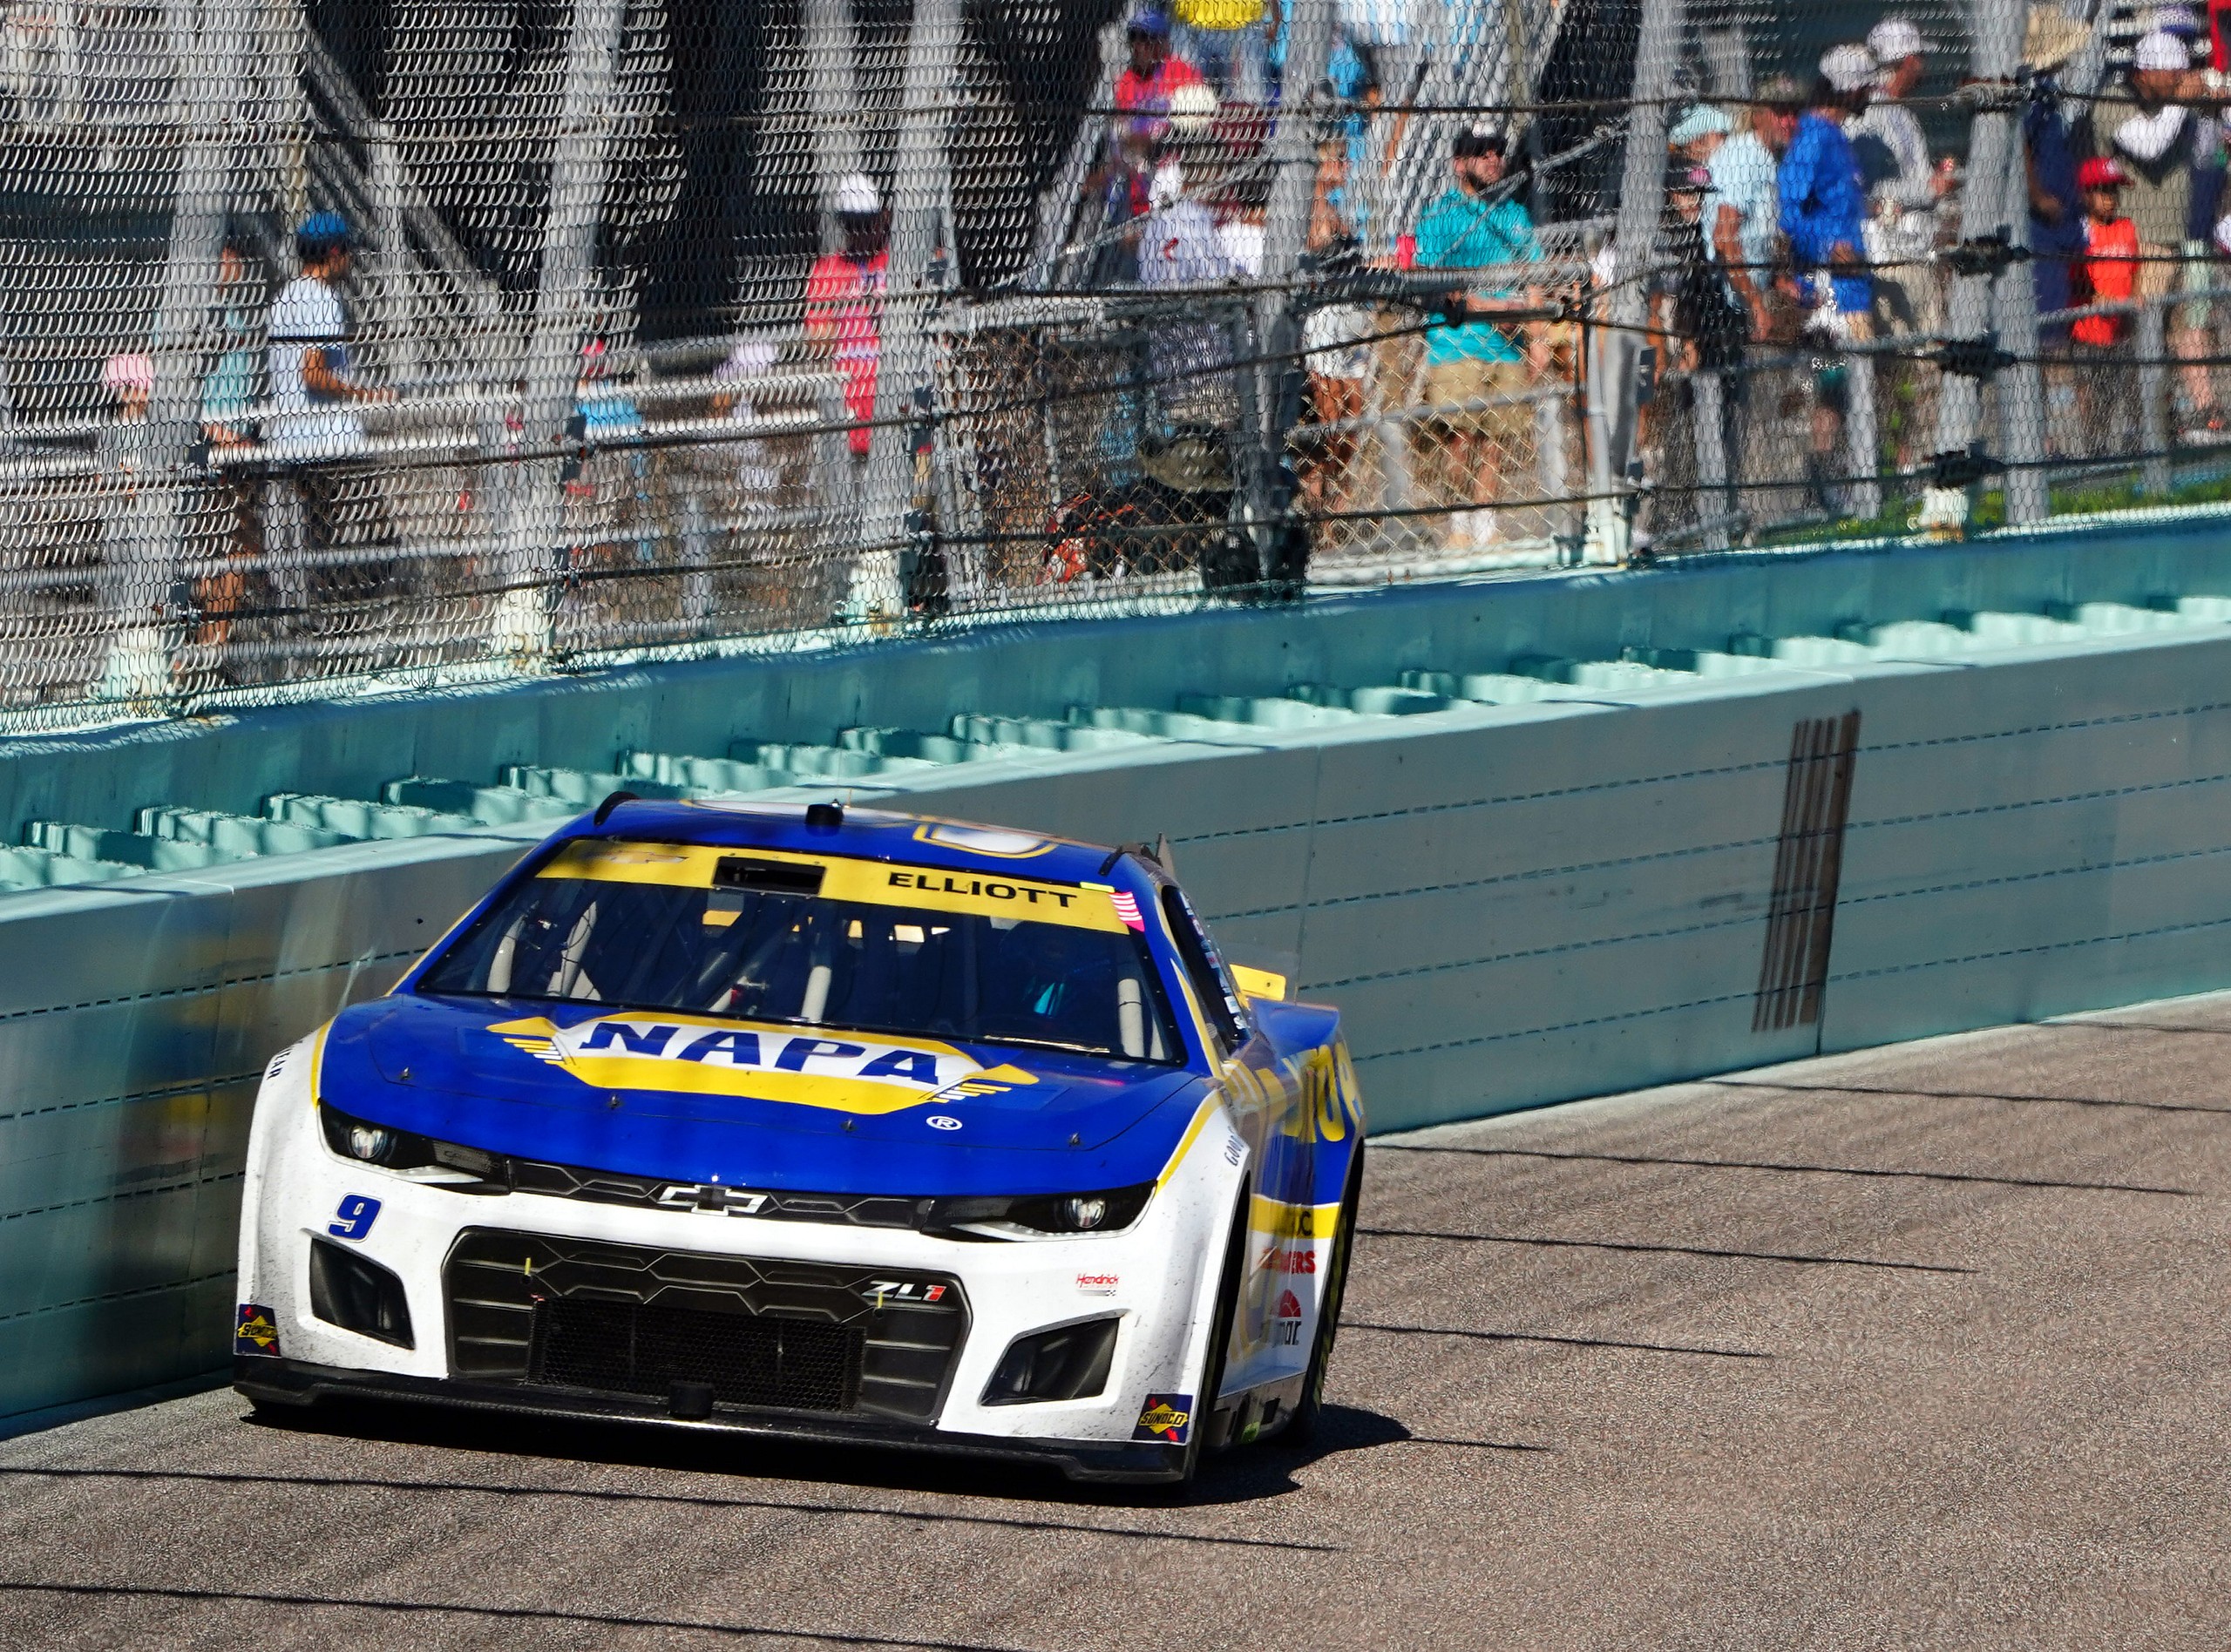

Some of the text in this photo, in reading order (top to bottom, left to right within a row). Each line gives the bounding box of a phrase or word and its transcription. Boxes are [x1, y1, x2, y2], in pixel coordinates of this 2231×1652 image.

[888, 872, 1077, 907] ELLIOTT
[579, 1022, 939, 1085] NAPA
[327, 1193, 383, 1242] 9
[861, 1280, 947, 1302] ZL1
[1140, 1412, 1186, 1426] SUNOCO
